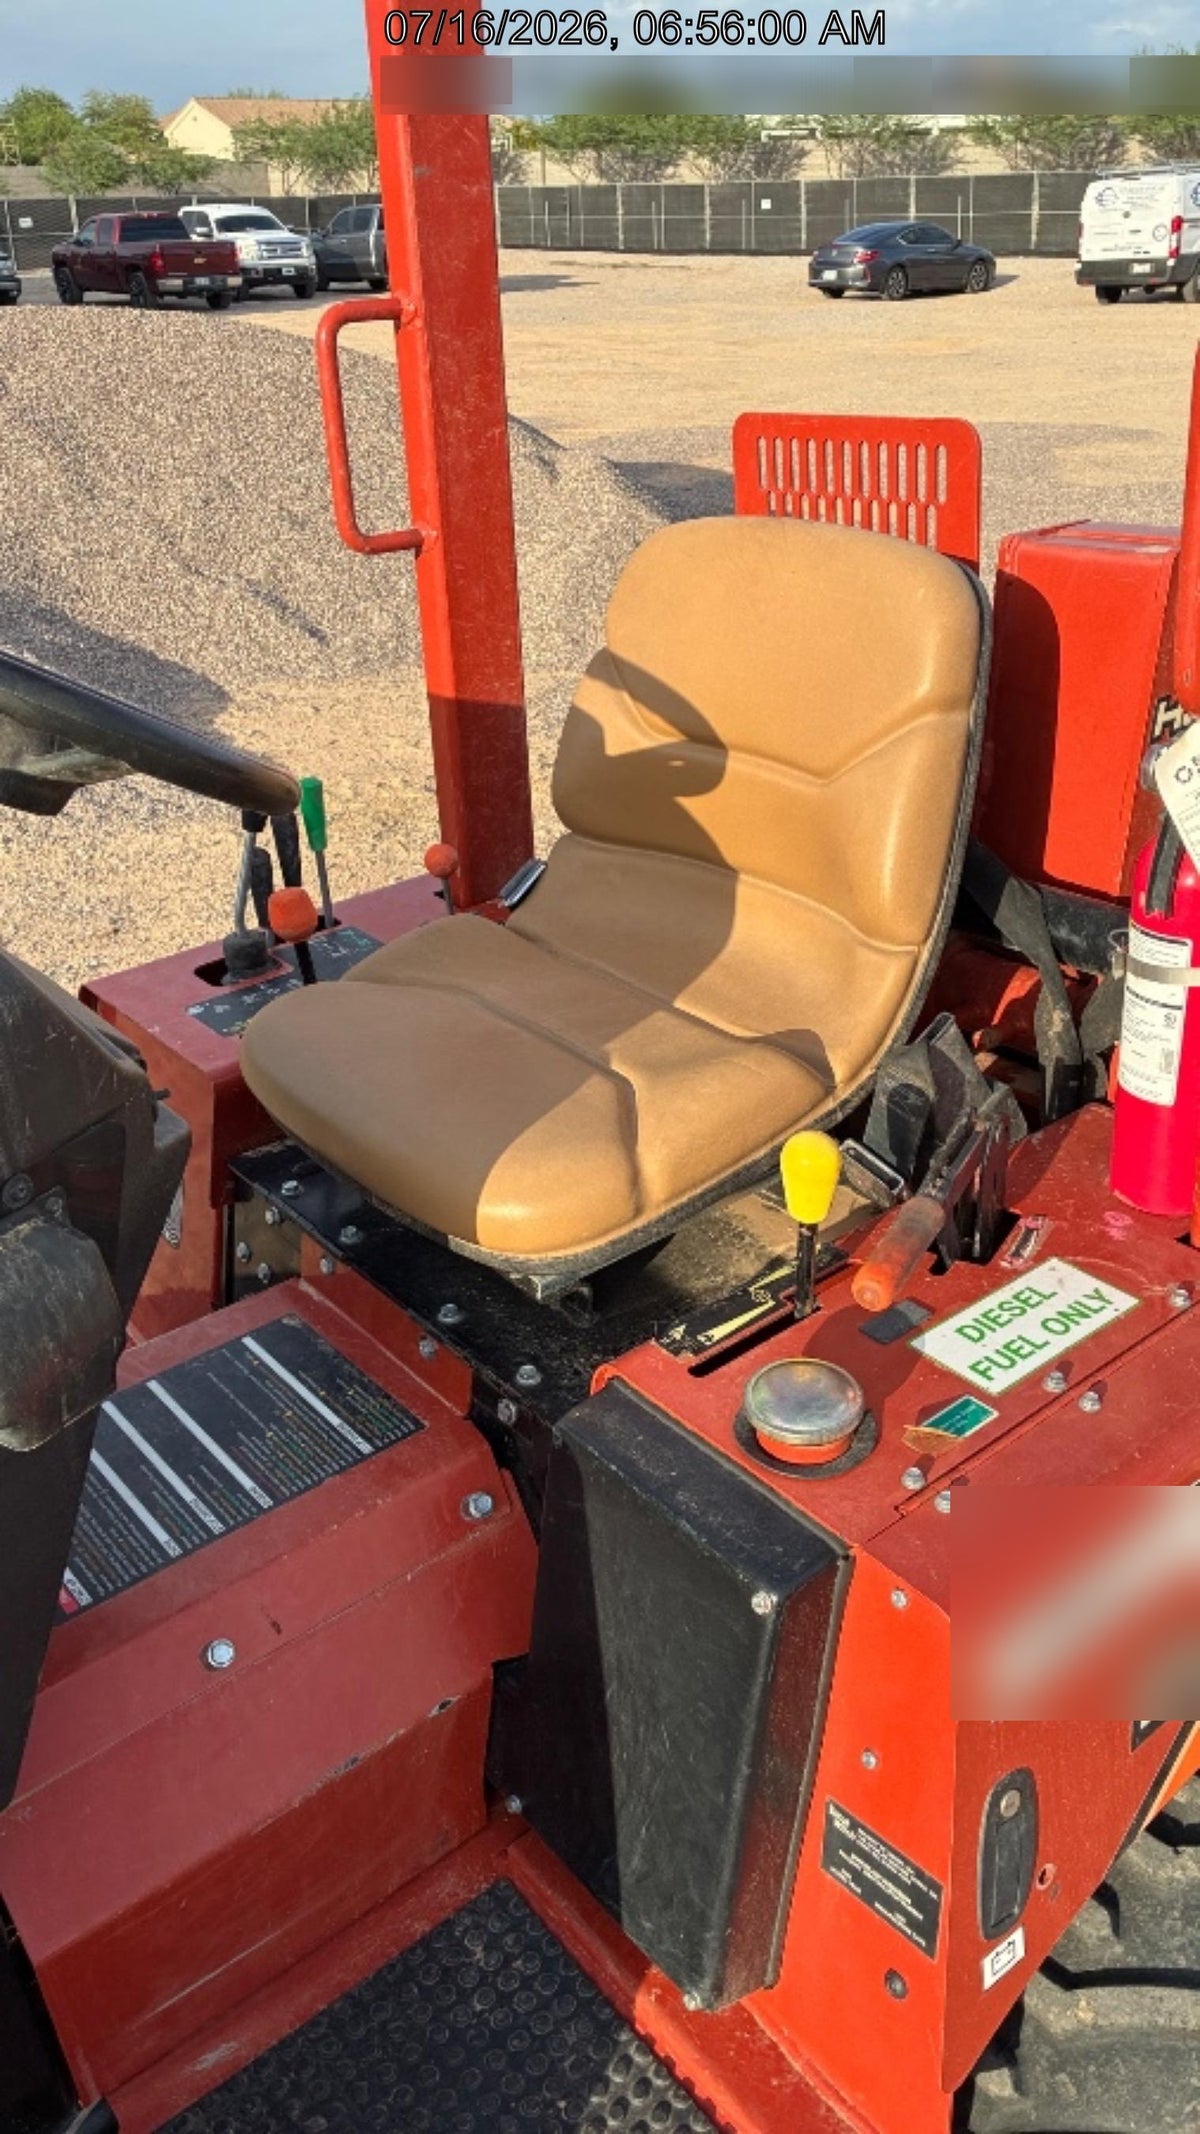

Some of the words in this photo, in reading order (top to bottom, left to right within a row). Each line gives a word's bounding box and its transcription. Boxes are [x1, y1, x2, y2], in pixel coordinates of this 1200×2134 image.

[955, 1286, 1059, 1344] DIESEL
[968, 1335, 1051, 1382] FUEL
[1041, 1287, 1114, 1336] ONLY
